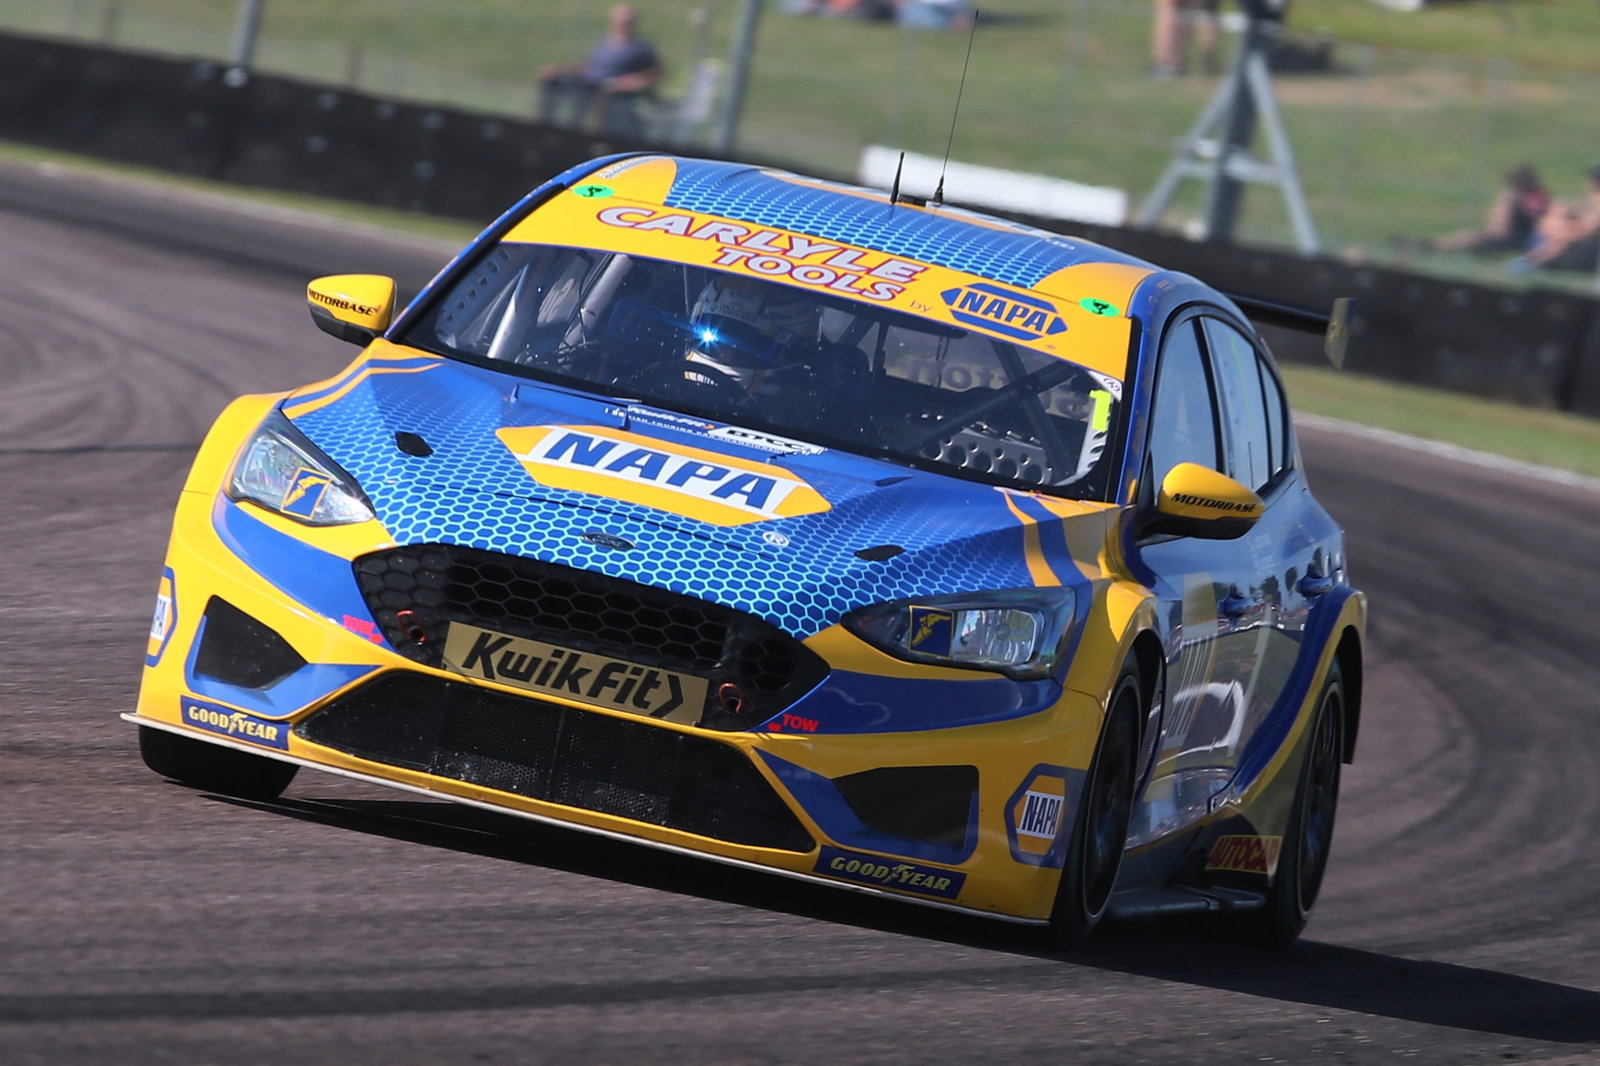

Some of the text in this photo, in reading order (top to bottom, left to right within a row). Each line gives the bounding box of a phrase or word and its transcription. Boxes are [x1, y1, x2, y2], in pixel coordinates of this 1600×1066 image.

[596, 206, 930, 284] CARLYLE
[712, 246, 907, 300] TOOLS
[308, 288, 376, 316] MOTORBASE
[957, 290, 1049, 333] NAPA
[543, 432, 778, 509] NAPA
[1171, 493, 1257, 513] MOTORBASE
[188, 705, 278, 741] GOODYEAR
[782, 713, 819, 733] TOW
[1021, 795, 1062, 836] NAPA
[830, 856, 952, 891] GOODYEAR
